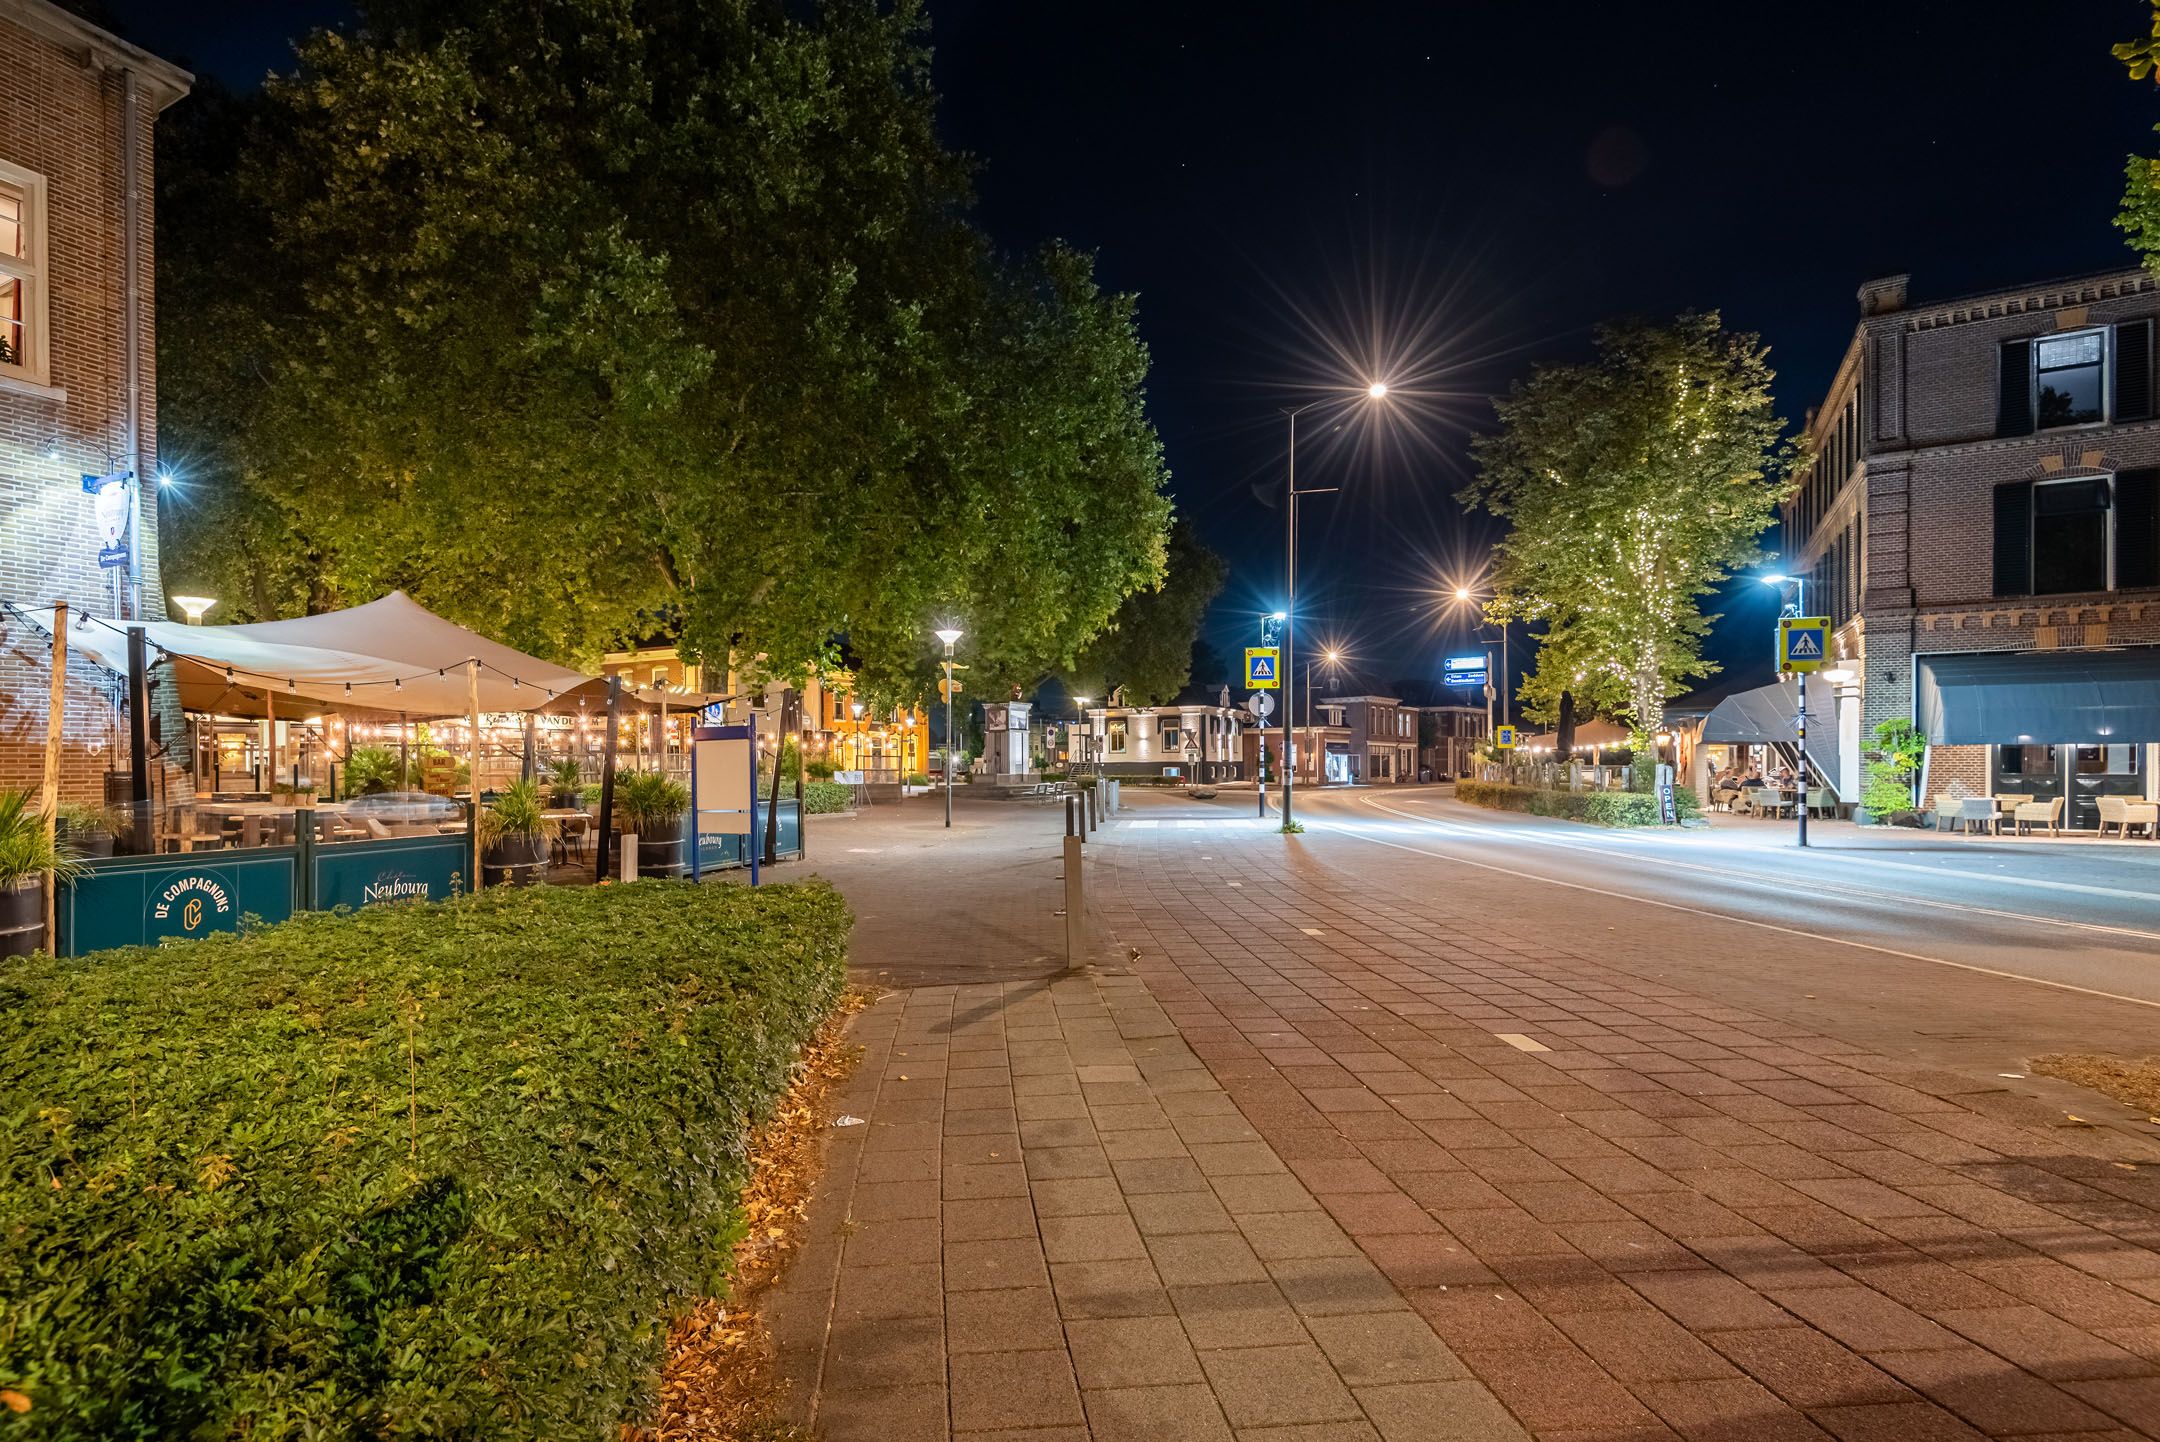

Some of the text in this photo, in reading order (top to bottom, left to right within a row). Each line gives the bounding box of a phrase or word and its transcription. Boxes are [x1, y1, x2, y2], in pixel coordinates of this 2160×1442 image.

[433, 758, 446, 766] BAR
[1663, 788, 1674, 818] OPEN
[154, 877, 229, 919] DE COMPAGNONS
